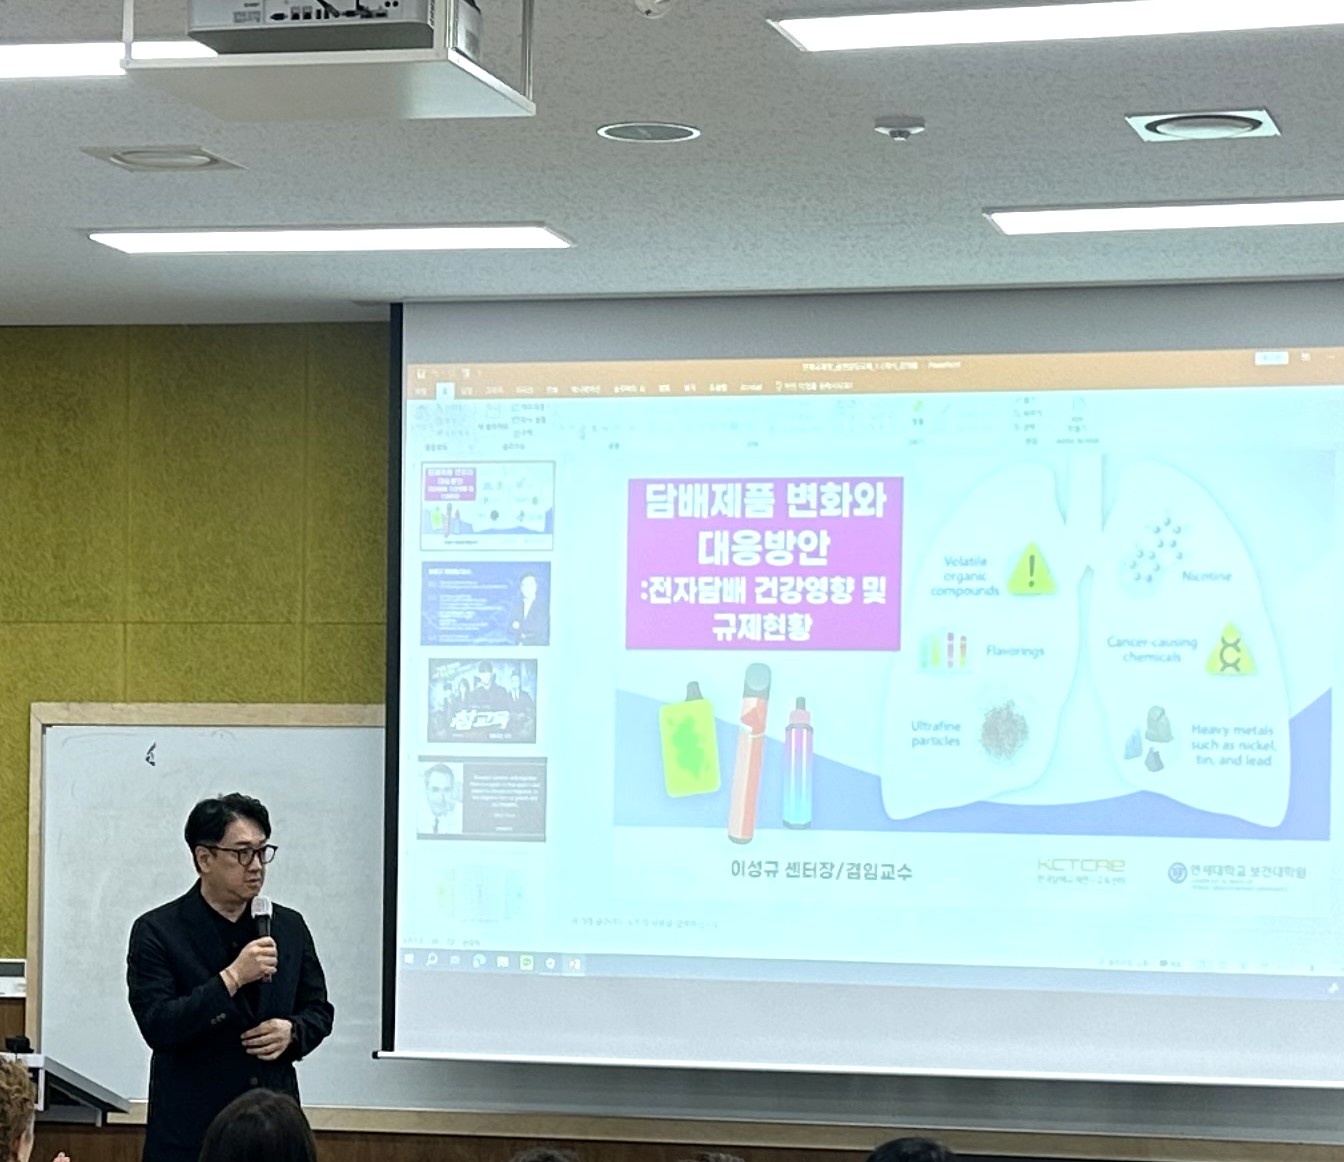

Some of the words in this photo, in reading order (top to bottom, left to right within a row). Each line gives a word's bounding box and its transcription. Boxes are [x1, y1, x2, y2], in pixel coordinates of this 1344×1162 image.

[645, 482, 775, 518] 담배제품
[787, 481, 887, 518] 변화와
[697, 529, 831, 567] 대응방안
[943, 555, 988, 568] Volatile
[943, 570, 987, 585] organic
[1181, 570, 1233, 583] Nicotine
[640, 575, 747, 605] :전자담배
[754, 576, 855, 605] 건강영향
[862, 577, 887, 605] 및
[930, 585, 1000, 599] compounds
[711, 614, 813, 642] 규제현황
[986, 644, 1045, 659] Flavorings
[1107, 636, 1198, 652] Cancer-causing
[1122, 651, 1182, 664] chemicals
[911, 720, 962, 733] Ultrafine
[1191, 724, 1229, 740] Heavy
[1232, 724, 1274, 738] metals
[911, 734, 962, 749] particles
[1191, 739, 1219, 752] such
[1222, 742, 1236, 752] as
[1218, 754, 1243, 767] and
[1246, 754, 1273, 767] lead
[731, 860, 779, 878] 이성규
[786, 860, 913, 881] 센터장/겸임교수
